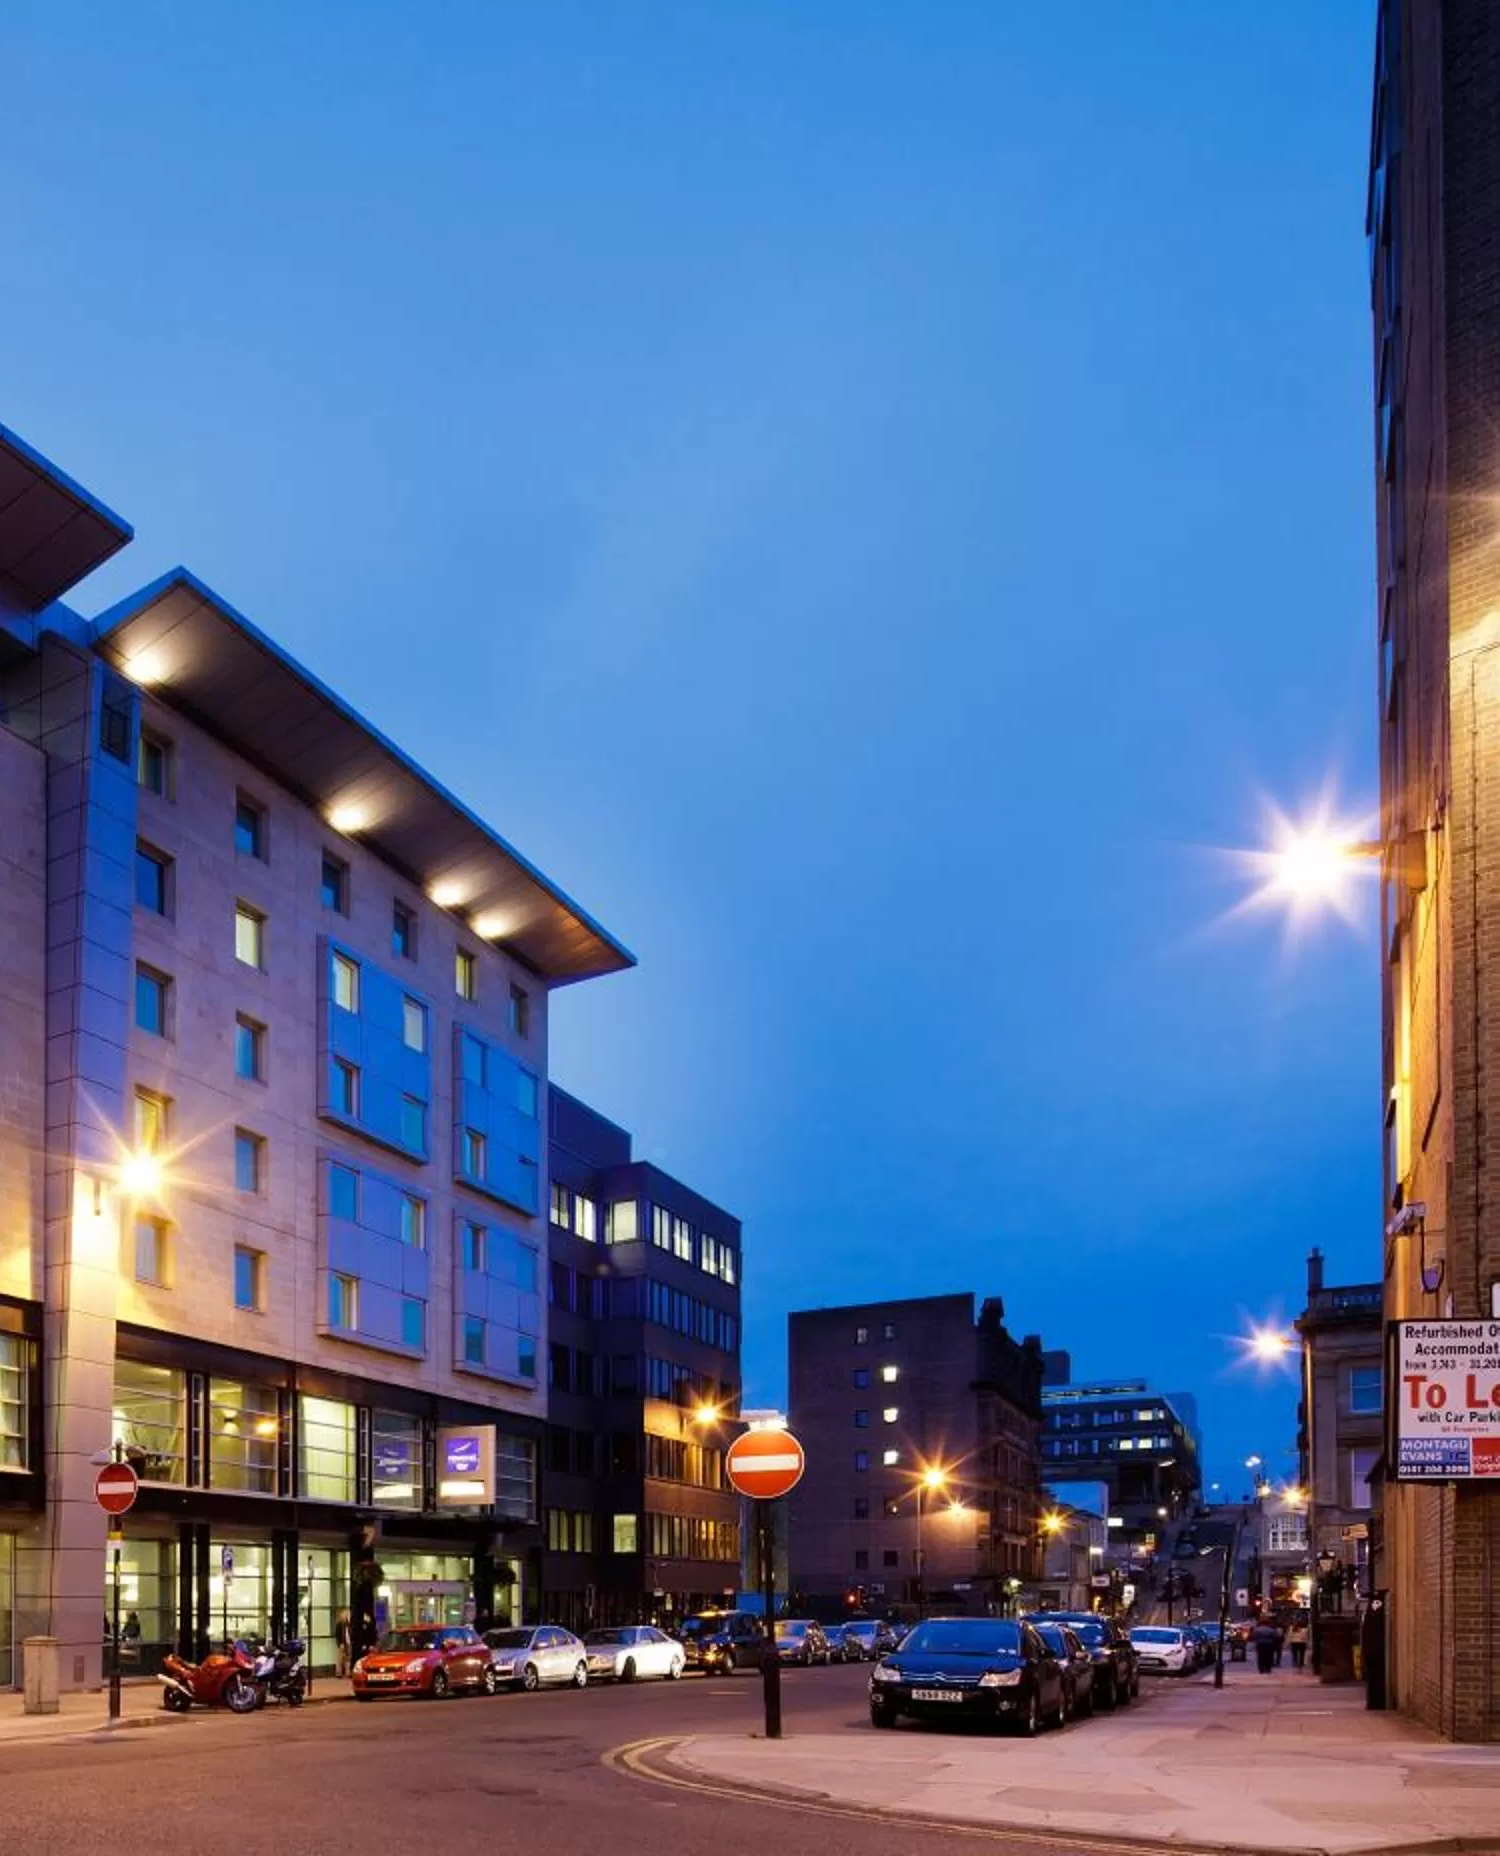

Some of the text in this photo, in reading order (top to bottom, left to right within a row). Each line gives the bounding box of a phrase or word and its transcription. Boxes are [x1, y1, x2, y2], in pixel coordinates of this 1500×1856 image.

[1405, 1324, 1500, 1339] Refurbished O
[1403, 1375, 1447, 1409] To
[1417, 1412, 1441, 1422] with
[1445, 1411, 1464, 1423] Car
[1402, 1440, 1469, 1450] MONTAGU
[1401, 1451, 1443, 1461] EVANS
